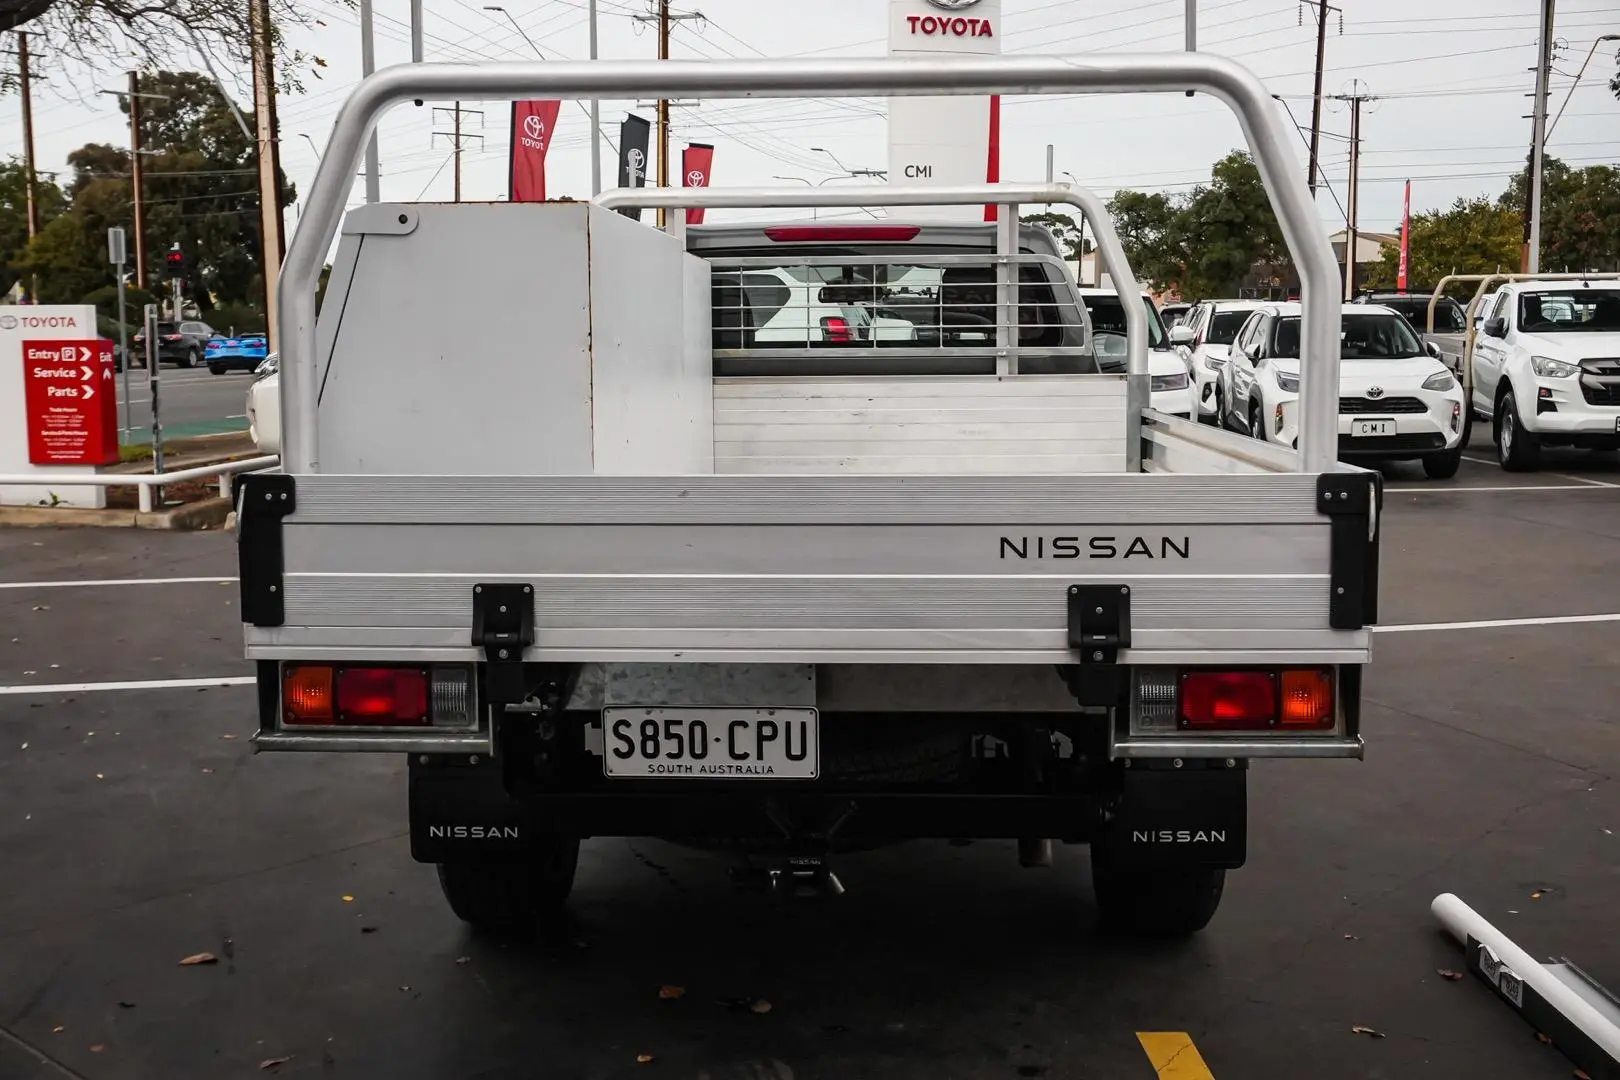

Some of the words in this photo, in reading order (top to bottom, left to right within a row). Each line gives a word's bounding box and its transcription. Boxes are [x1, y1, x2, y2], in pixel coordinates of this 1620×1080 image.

[906, 16, 993, 38] TOYOTA
[521, 136, 545, 150] TOYOT
[904, 165, 932, 178] CMI
[21, 317, 77, 328] TOYOTA
[28, 348, 60, 362] Entry
[33, 367, 77, 378] Service
[47, 386, 78, 397] Parts
[1000, 536, 1190, 559] NISSAN
[648, 764, 693, 774] SOUTH
[699, 764, 775, 775] AUSTRALIA
[429, 825, 519, 838] NISSAN
[1133, 830, 1226, 843] NISSAN
